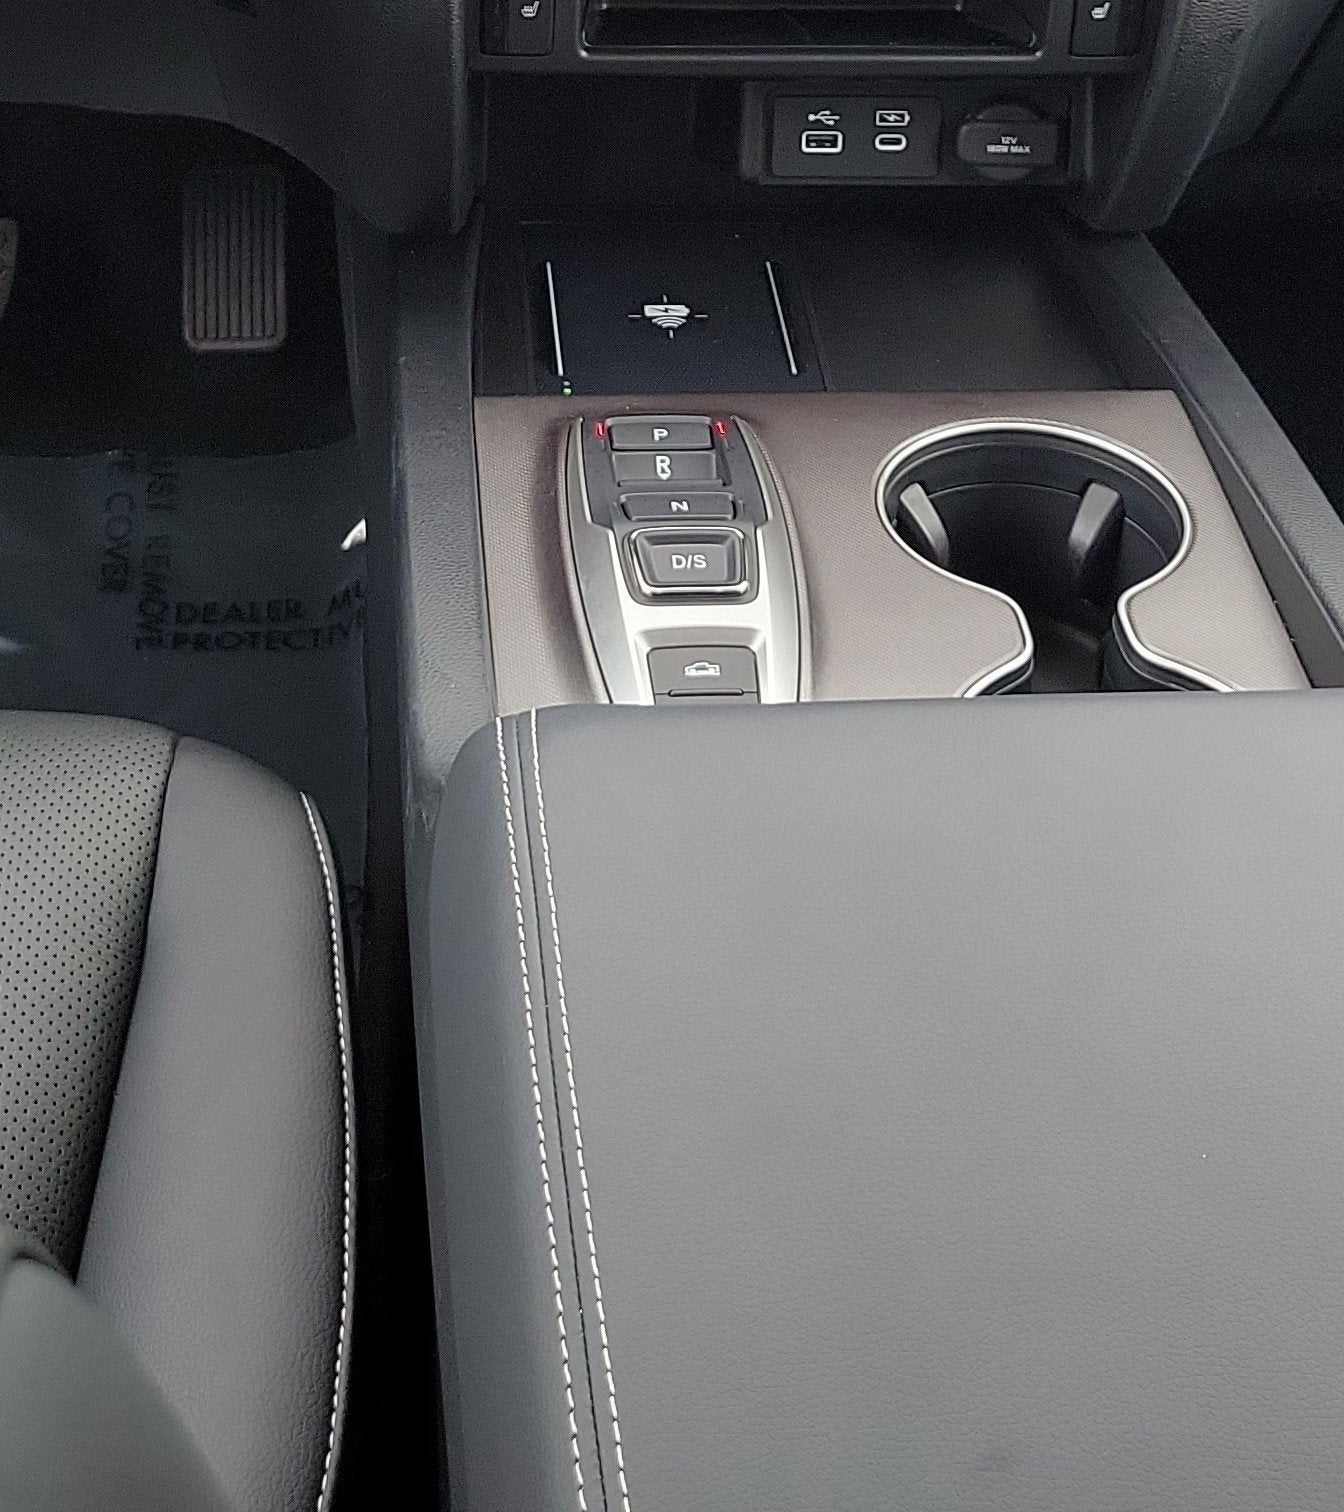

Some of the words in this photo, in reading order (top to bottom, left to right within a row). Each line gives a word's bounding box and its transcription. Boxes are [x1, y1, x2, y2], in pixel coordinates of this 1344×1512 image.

[653, 428, 669, 441] P
[656, 455, 671, 472] R
[670, 500, 689, 512] N
[671, 553, 707, 570] D/S
[176, 598, 305, 625] DEALER
